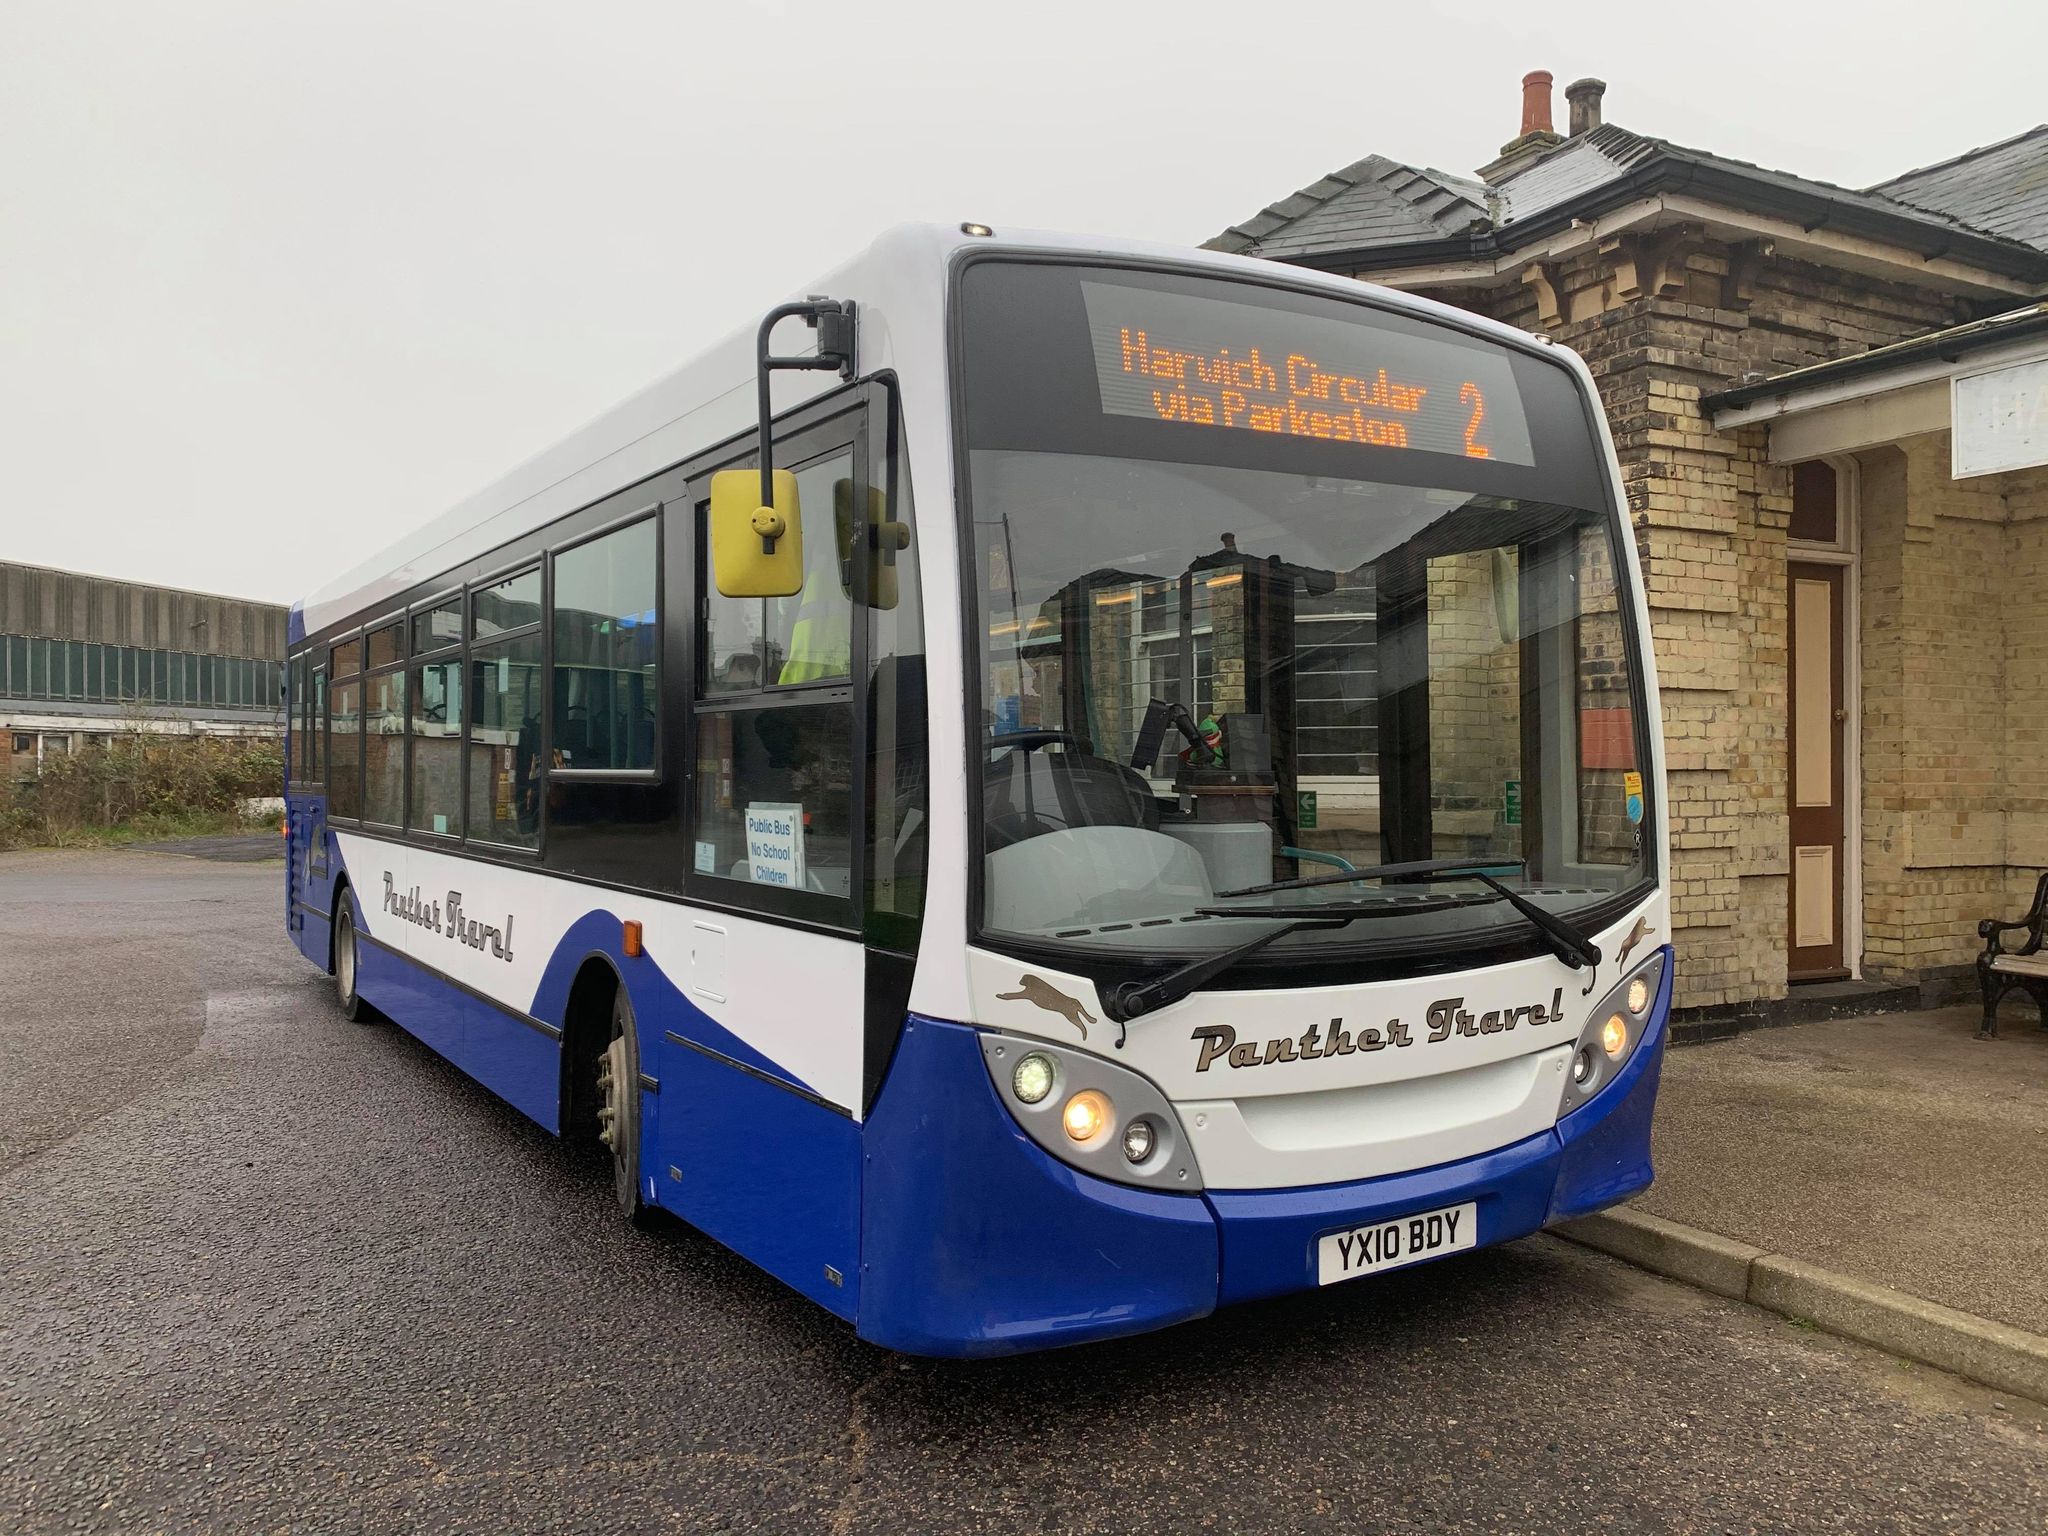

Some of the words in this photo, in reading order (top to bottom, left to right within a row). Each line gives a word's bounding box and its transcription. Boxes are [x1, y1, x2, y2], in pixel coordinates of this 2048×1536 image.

[1120, 328, 1276, 391] Harwich
[1287, 354, 1426, 411] Circular
[1153, 383, 1214, 424] via
[1222, 390, 1407, 448] Parkeston
[1459, 381, 1489, 457] 2
[749, 818, 773, 834] Public
[774, 820, 790, 835] Bus
[751, 842, 761, 856] No
[763, 843, 790, 860] School
[756, 865, 788, 884] Children
[383, 870, 442, 934] Panther
[446, 890, 514, 963] Travel
[1191, 1017, 1413, 1073] Panther
[1426, 988, 1563, 1043] Travel
[1337, 1225, 1400, 1271] YX10
[1408, 1210, 1460, 1254] BDY
